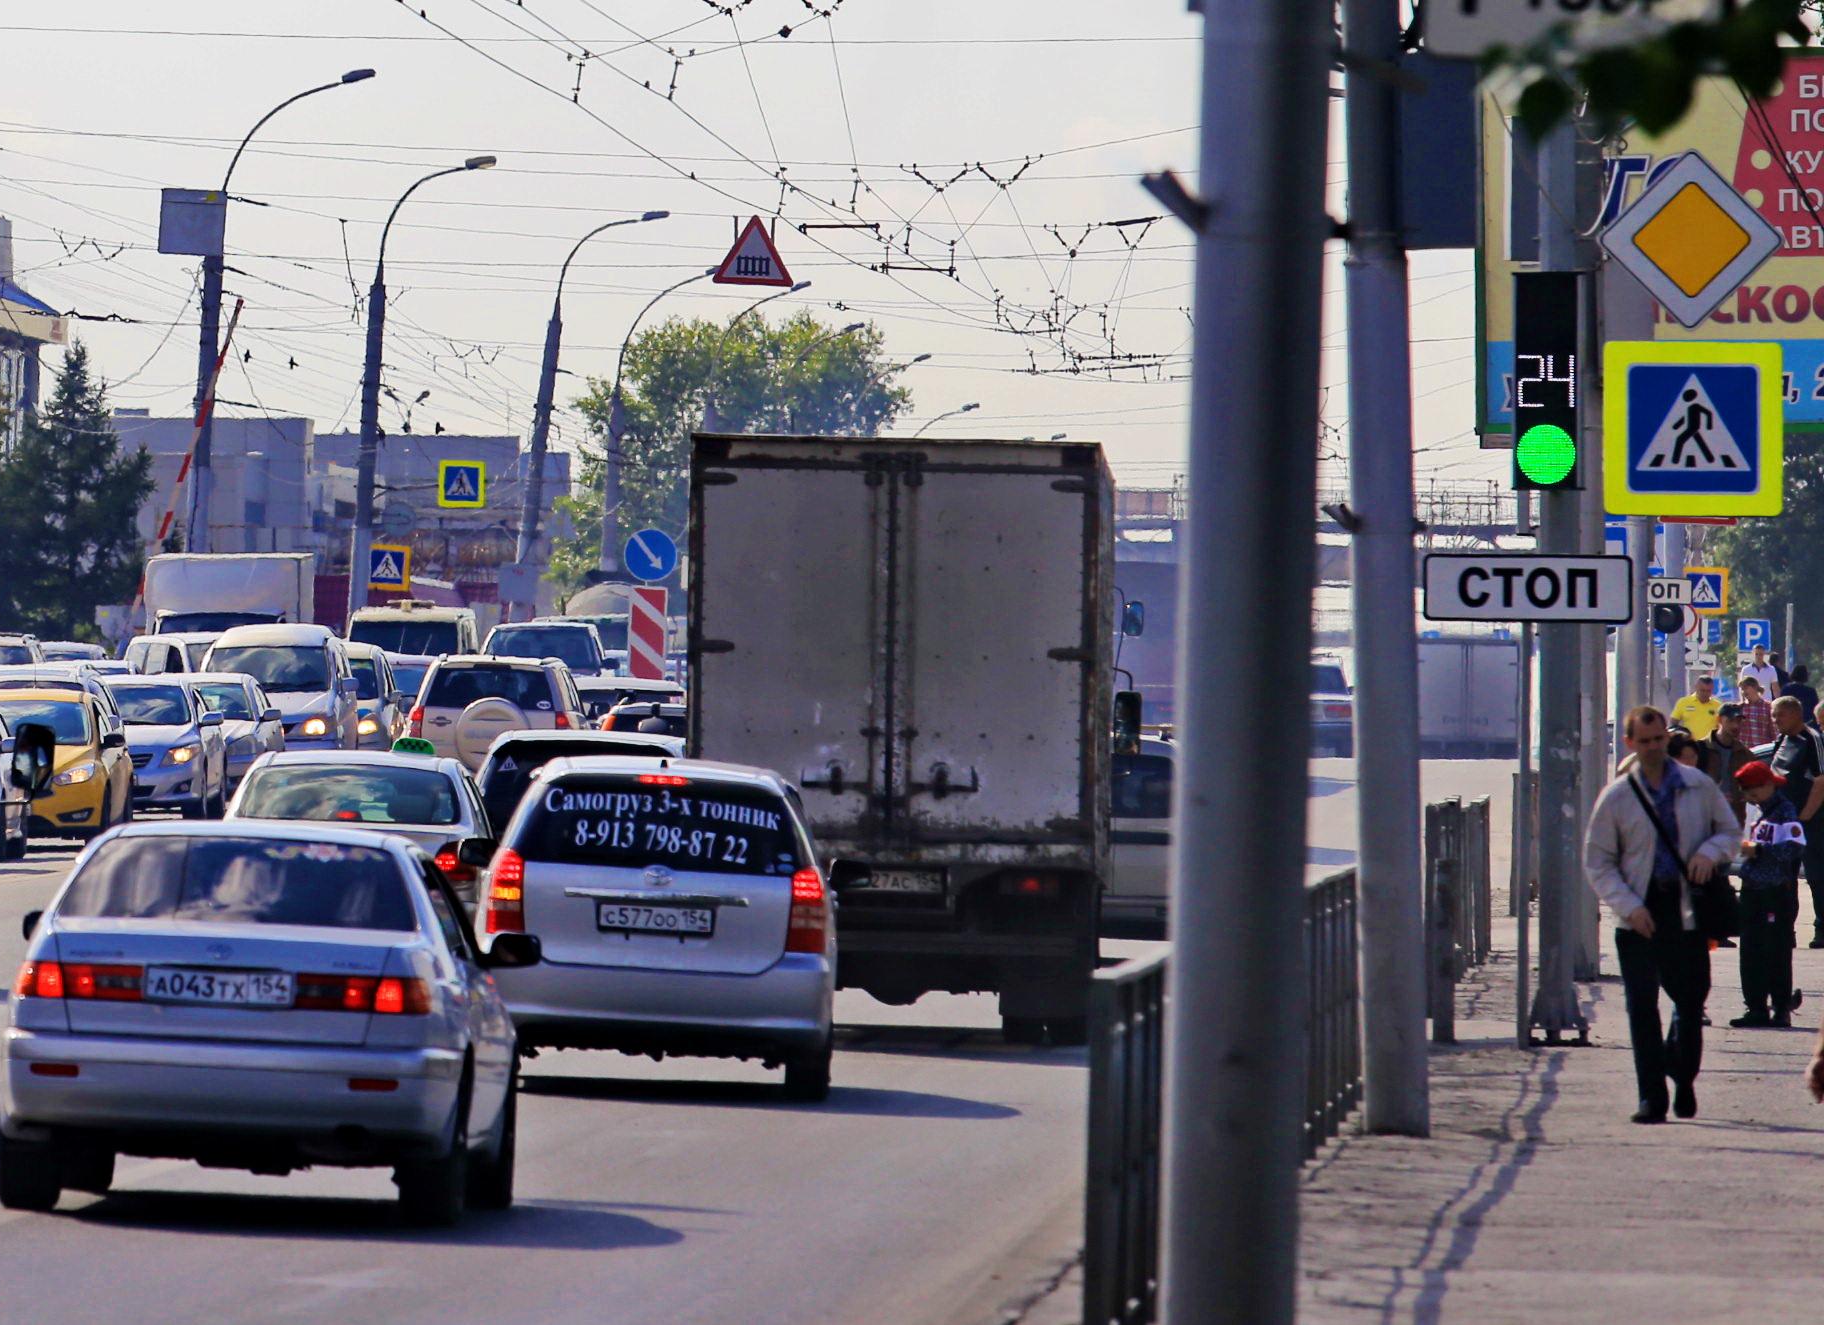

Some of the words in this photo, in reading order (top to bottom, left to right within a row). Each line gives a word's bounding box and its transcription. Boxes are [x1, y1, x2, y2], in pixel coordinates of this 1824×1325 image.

[1799, 74, 1824, 98] Б
[1517, 354, 1575, 408] 24
[1457, 566, 1599, 609] СТОП
[1648, 582, 1680, 600] ОП
[544, 787, 653, 819] Самогруз
[658, 790, 692, 816] 3-х
[700, 799, 781, 832] тонник
[574, 818, 636, 849] 8-913
[645, 822, 717, 860] 798-87
[722, 834, 749, 865] 22
[681, 910, 708, 926] 154
[154, 973, 246, 1000] А043ТХ
[251, 976, 289, 995] 154
